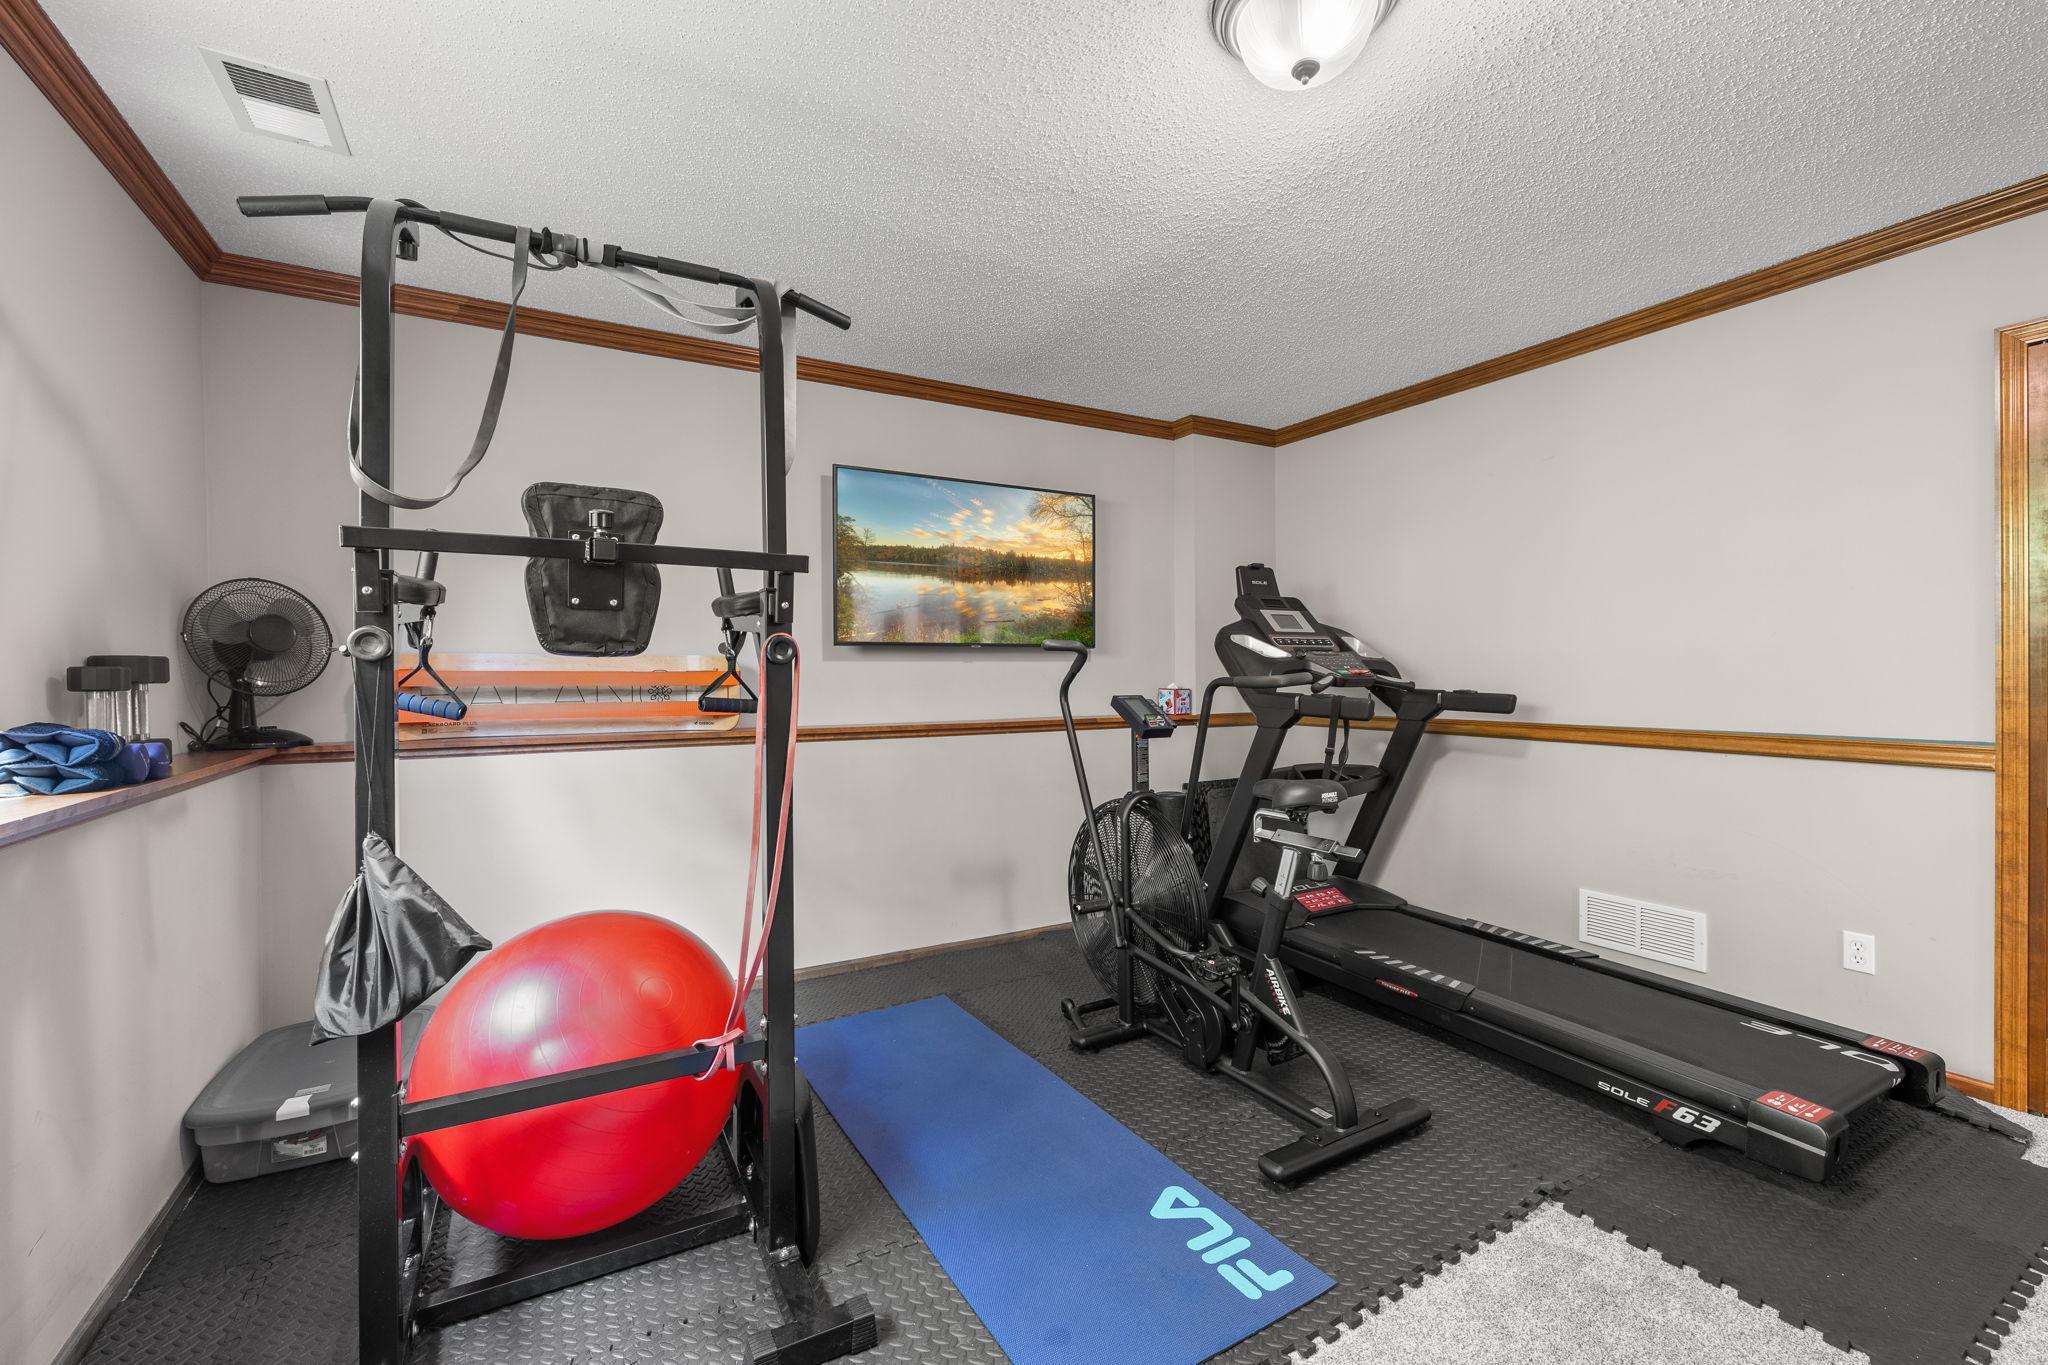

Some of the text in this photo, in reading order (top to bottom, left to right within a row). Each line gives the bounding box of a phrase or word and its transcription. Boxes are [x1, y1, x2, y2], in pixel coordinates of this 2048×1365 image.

[1266, 968, 1292, 1015] AIRBIKE
[1597, 1081, 1722, 1133] SOLE F63
[1150, 1185, 1295, 1300] FILA
